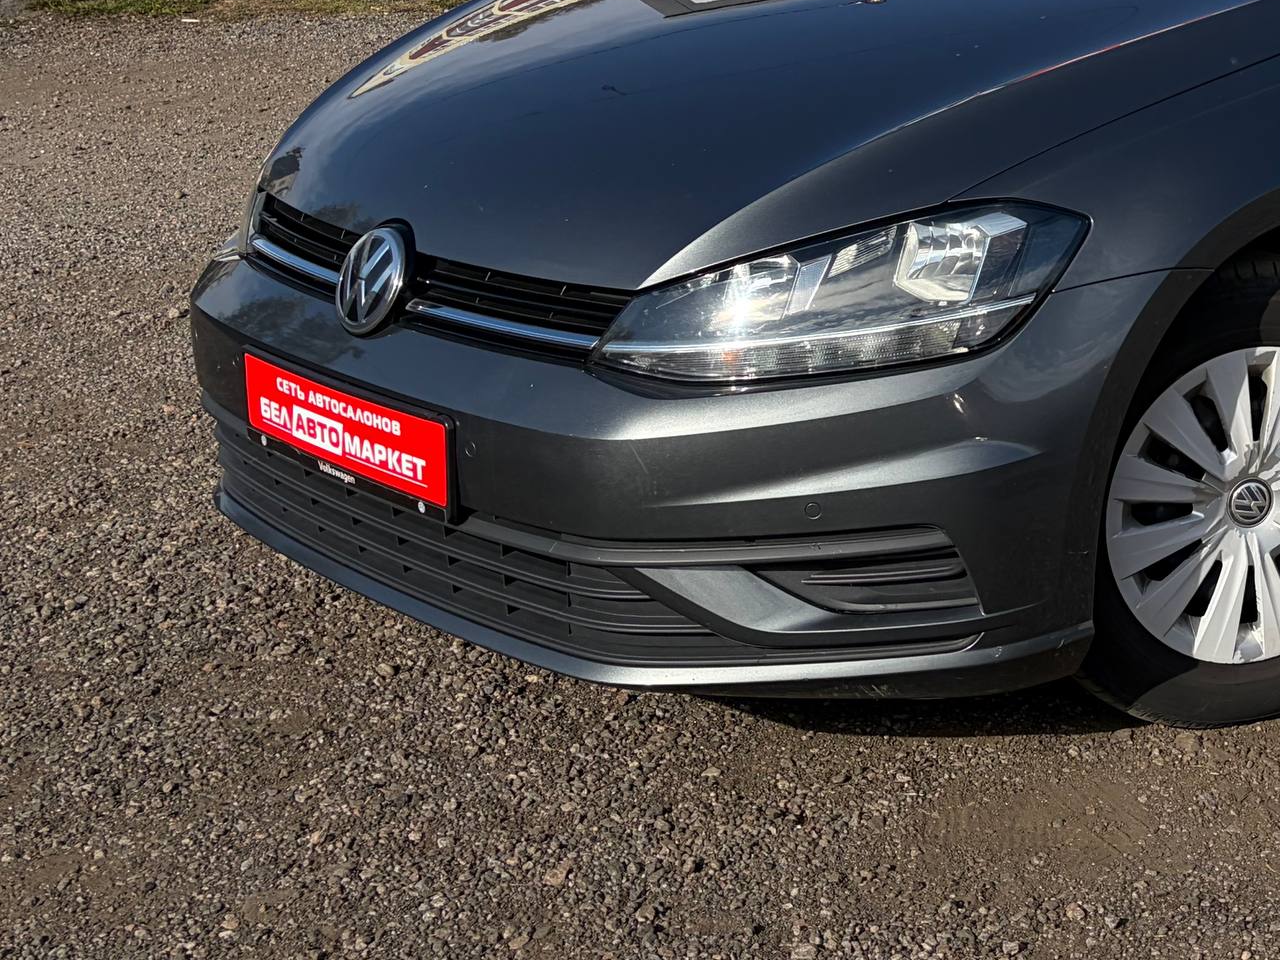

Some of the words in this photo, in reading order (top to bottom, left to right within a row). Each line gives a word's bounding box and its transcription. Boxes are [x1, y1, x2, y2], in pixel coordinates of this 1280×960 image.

[276, 376, 305, 401] СЕТЬ
[308, 390, 401, 436] АВТОСАЛОНОВ
[260, 396, 291, 429] БЕЛ
[294, 409, 341, 449] АВТО
[343, 431, 427, 481] МАРКЕТ
[317, 460, 356, 485] Volkswagen
